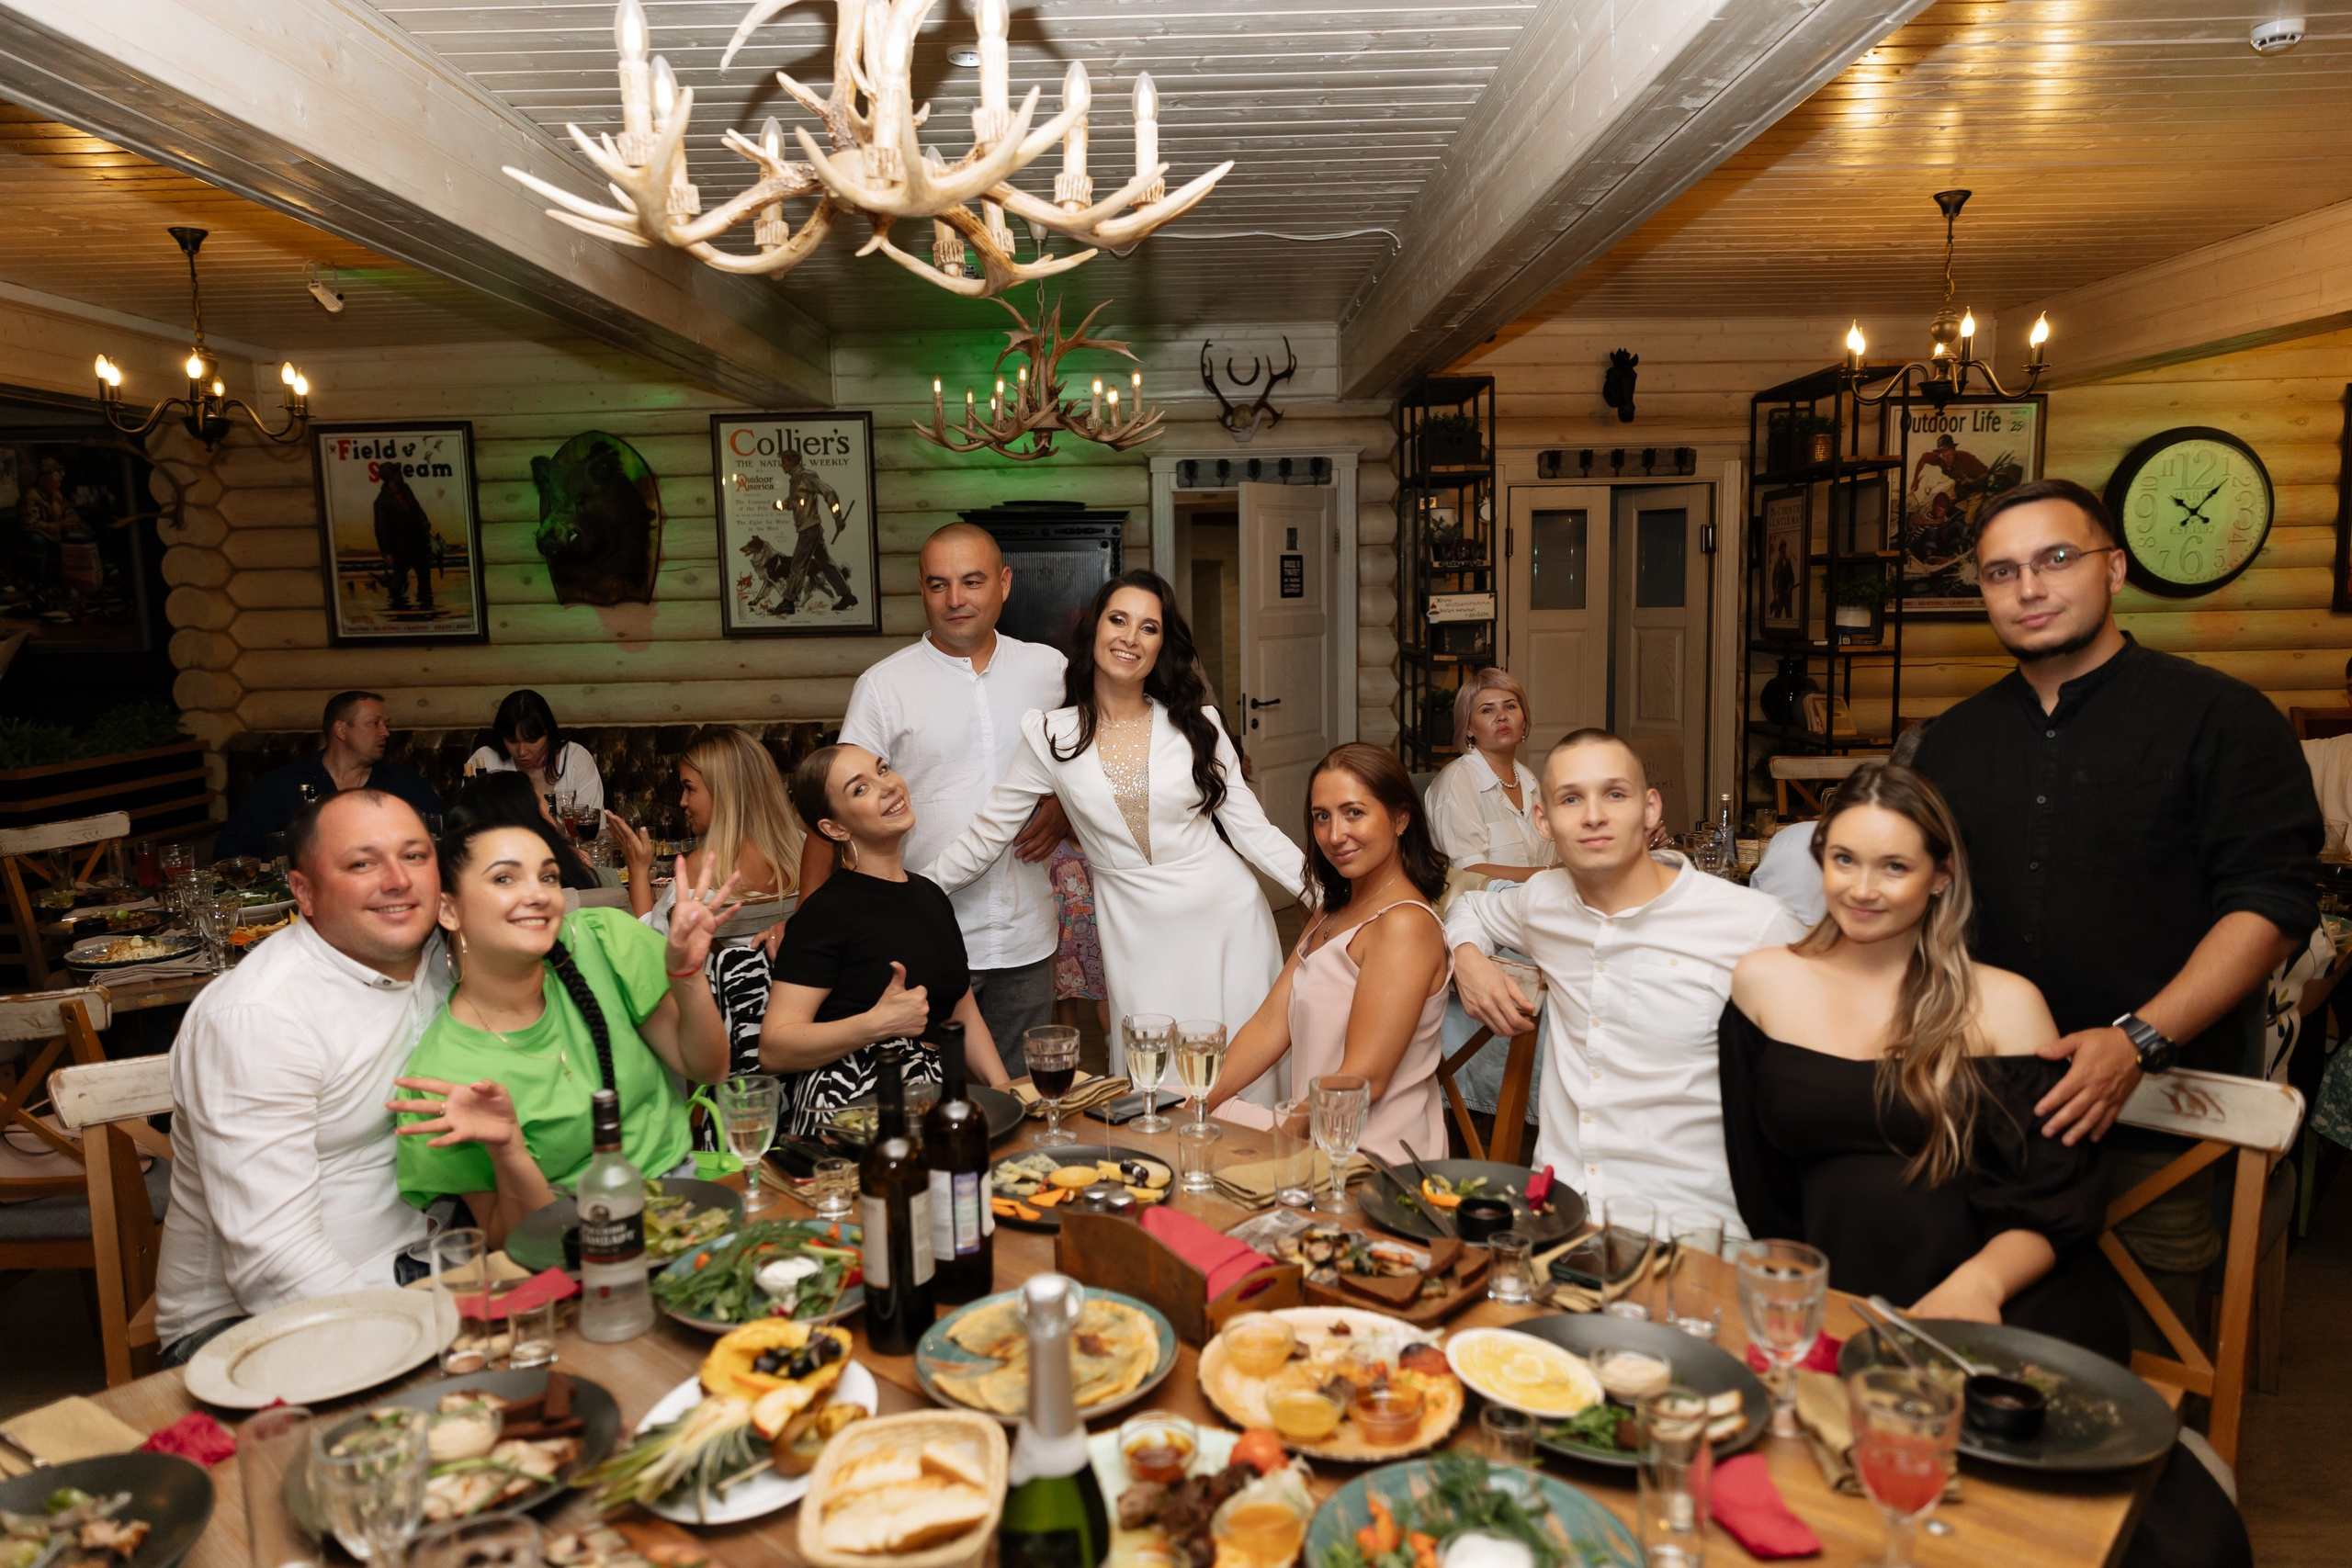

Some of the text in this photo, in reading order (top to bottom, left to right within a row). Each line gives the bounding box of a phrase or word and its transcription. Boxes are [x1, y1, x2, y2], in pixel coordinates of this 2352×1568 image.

[1973, 410, 2001, 433] Life
[336, 438, 397, 461] Field
[729, 428, 850, 457] Collier's
[368, 461, 453, 483] Seam
[809, 458, 850, 467] WEEKLY
[2160, 457, 2176, 477] 11
[2175, 449, 2218, 491] 12
[2221, 457, 2233, 476] 1
[2140, 475, 2158, 491] 10
[2232, 476, 2252, 488] 2
[2176, 491, 2211, 501] PARI
[2134, 492, 2157, 535] 9
[2233, 490, 2256, 532] 3
[2137, 536, 2156, 548] 8
[2158, 549, 2170, 570] 7
[2178, 535, 2203, 576] 6
[2213, 547, 2225, 569] 5
